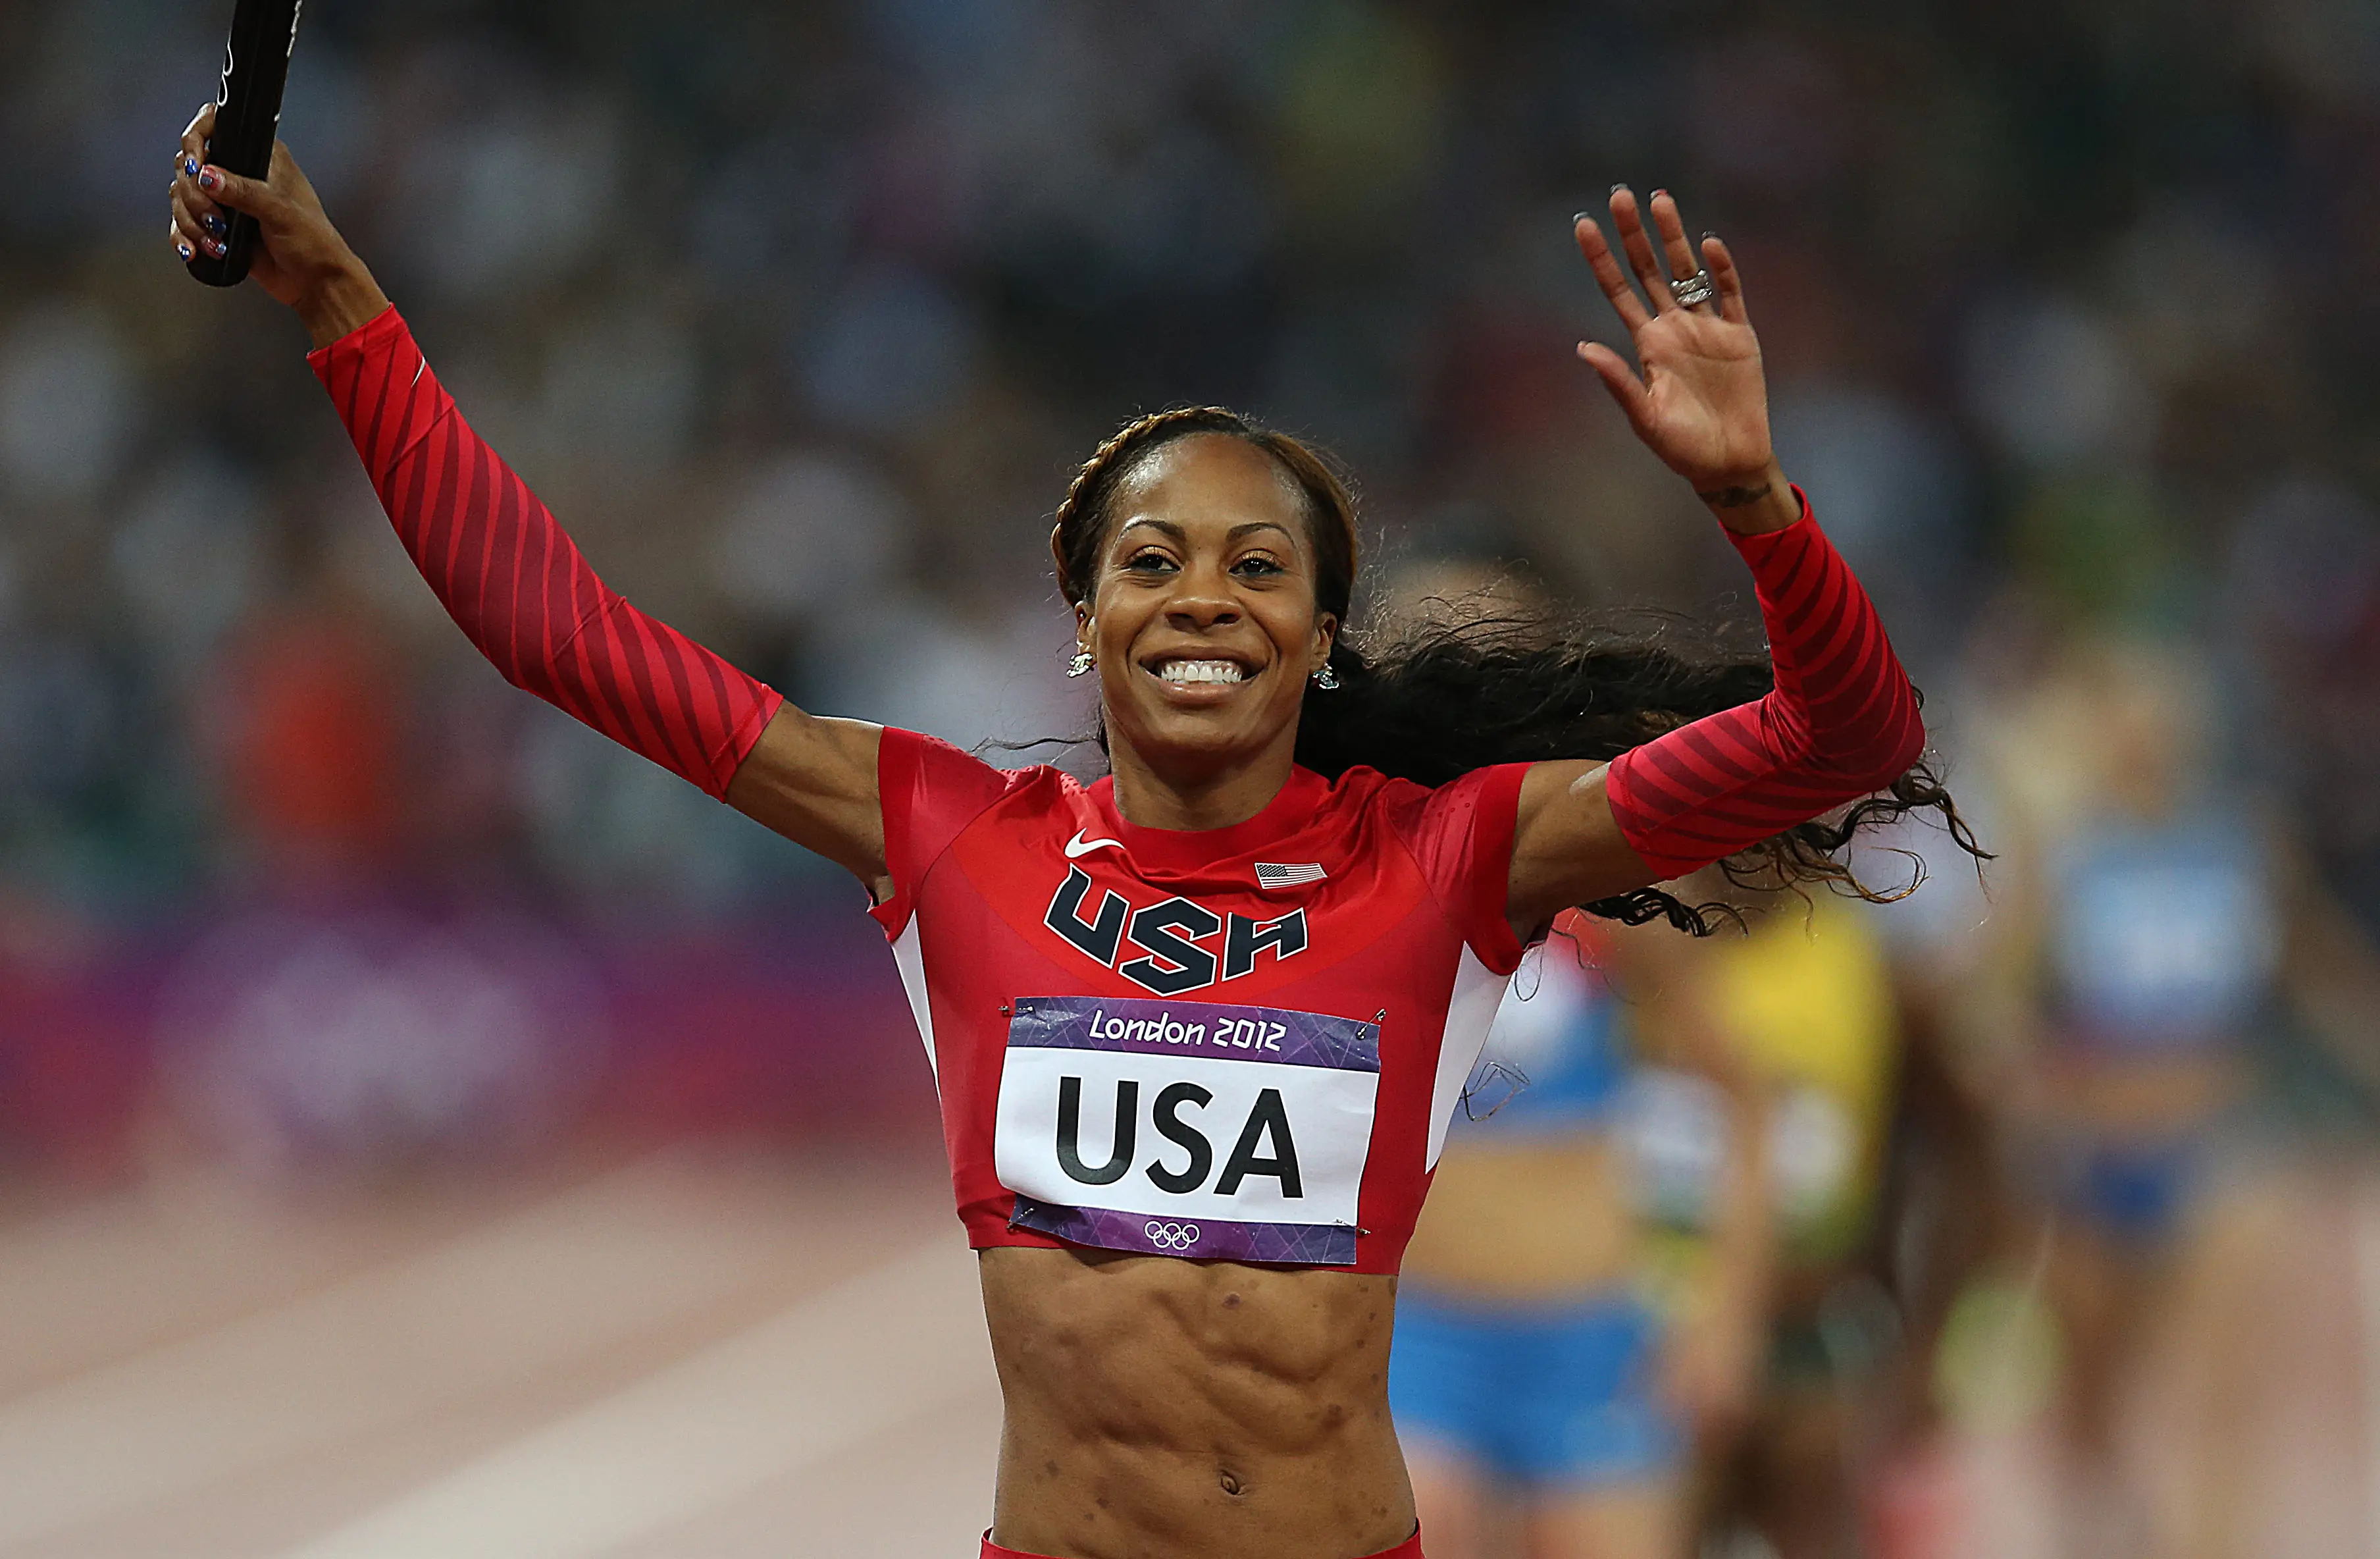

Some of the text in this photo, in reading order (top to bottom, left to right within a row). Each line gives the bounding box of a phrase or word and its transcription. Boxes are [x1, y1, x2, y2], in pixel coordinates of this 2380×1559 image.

[1044, 863, 1308, 996] USA
[1089, 1009, 1287, 1053] London 2012
[1056, 1076, 1304, 1200] USA
